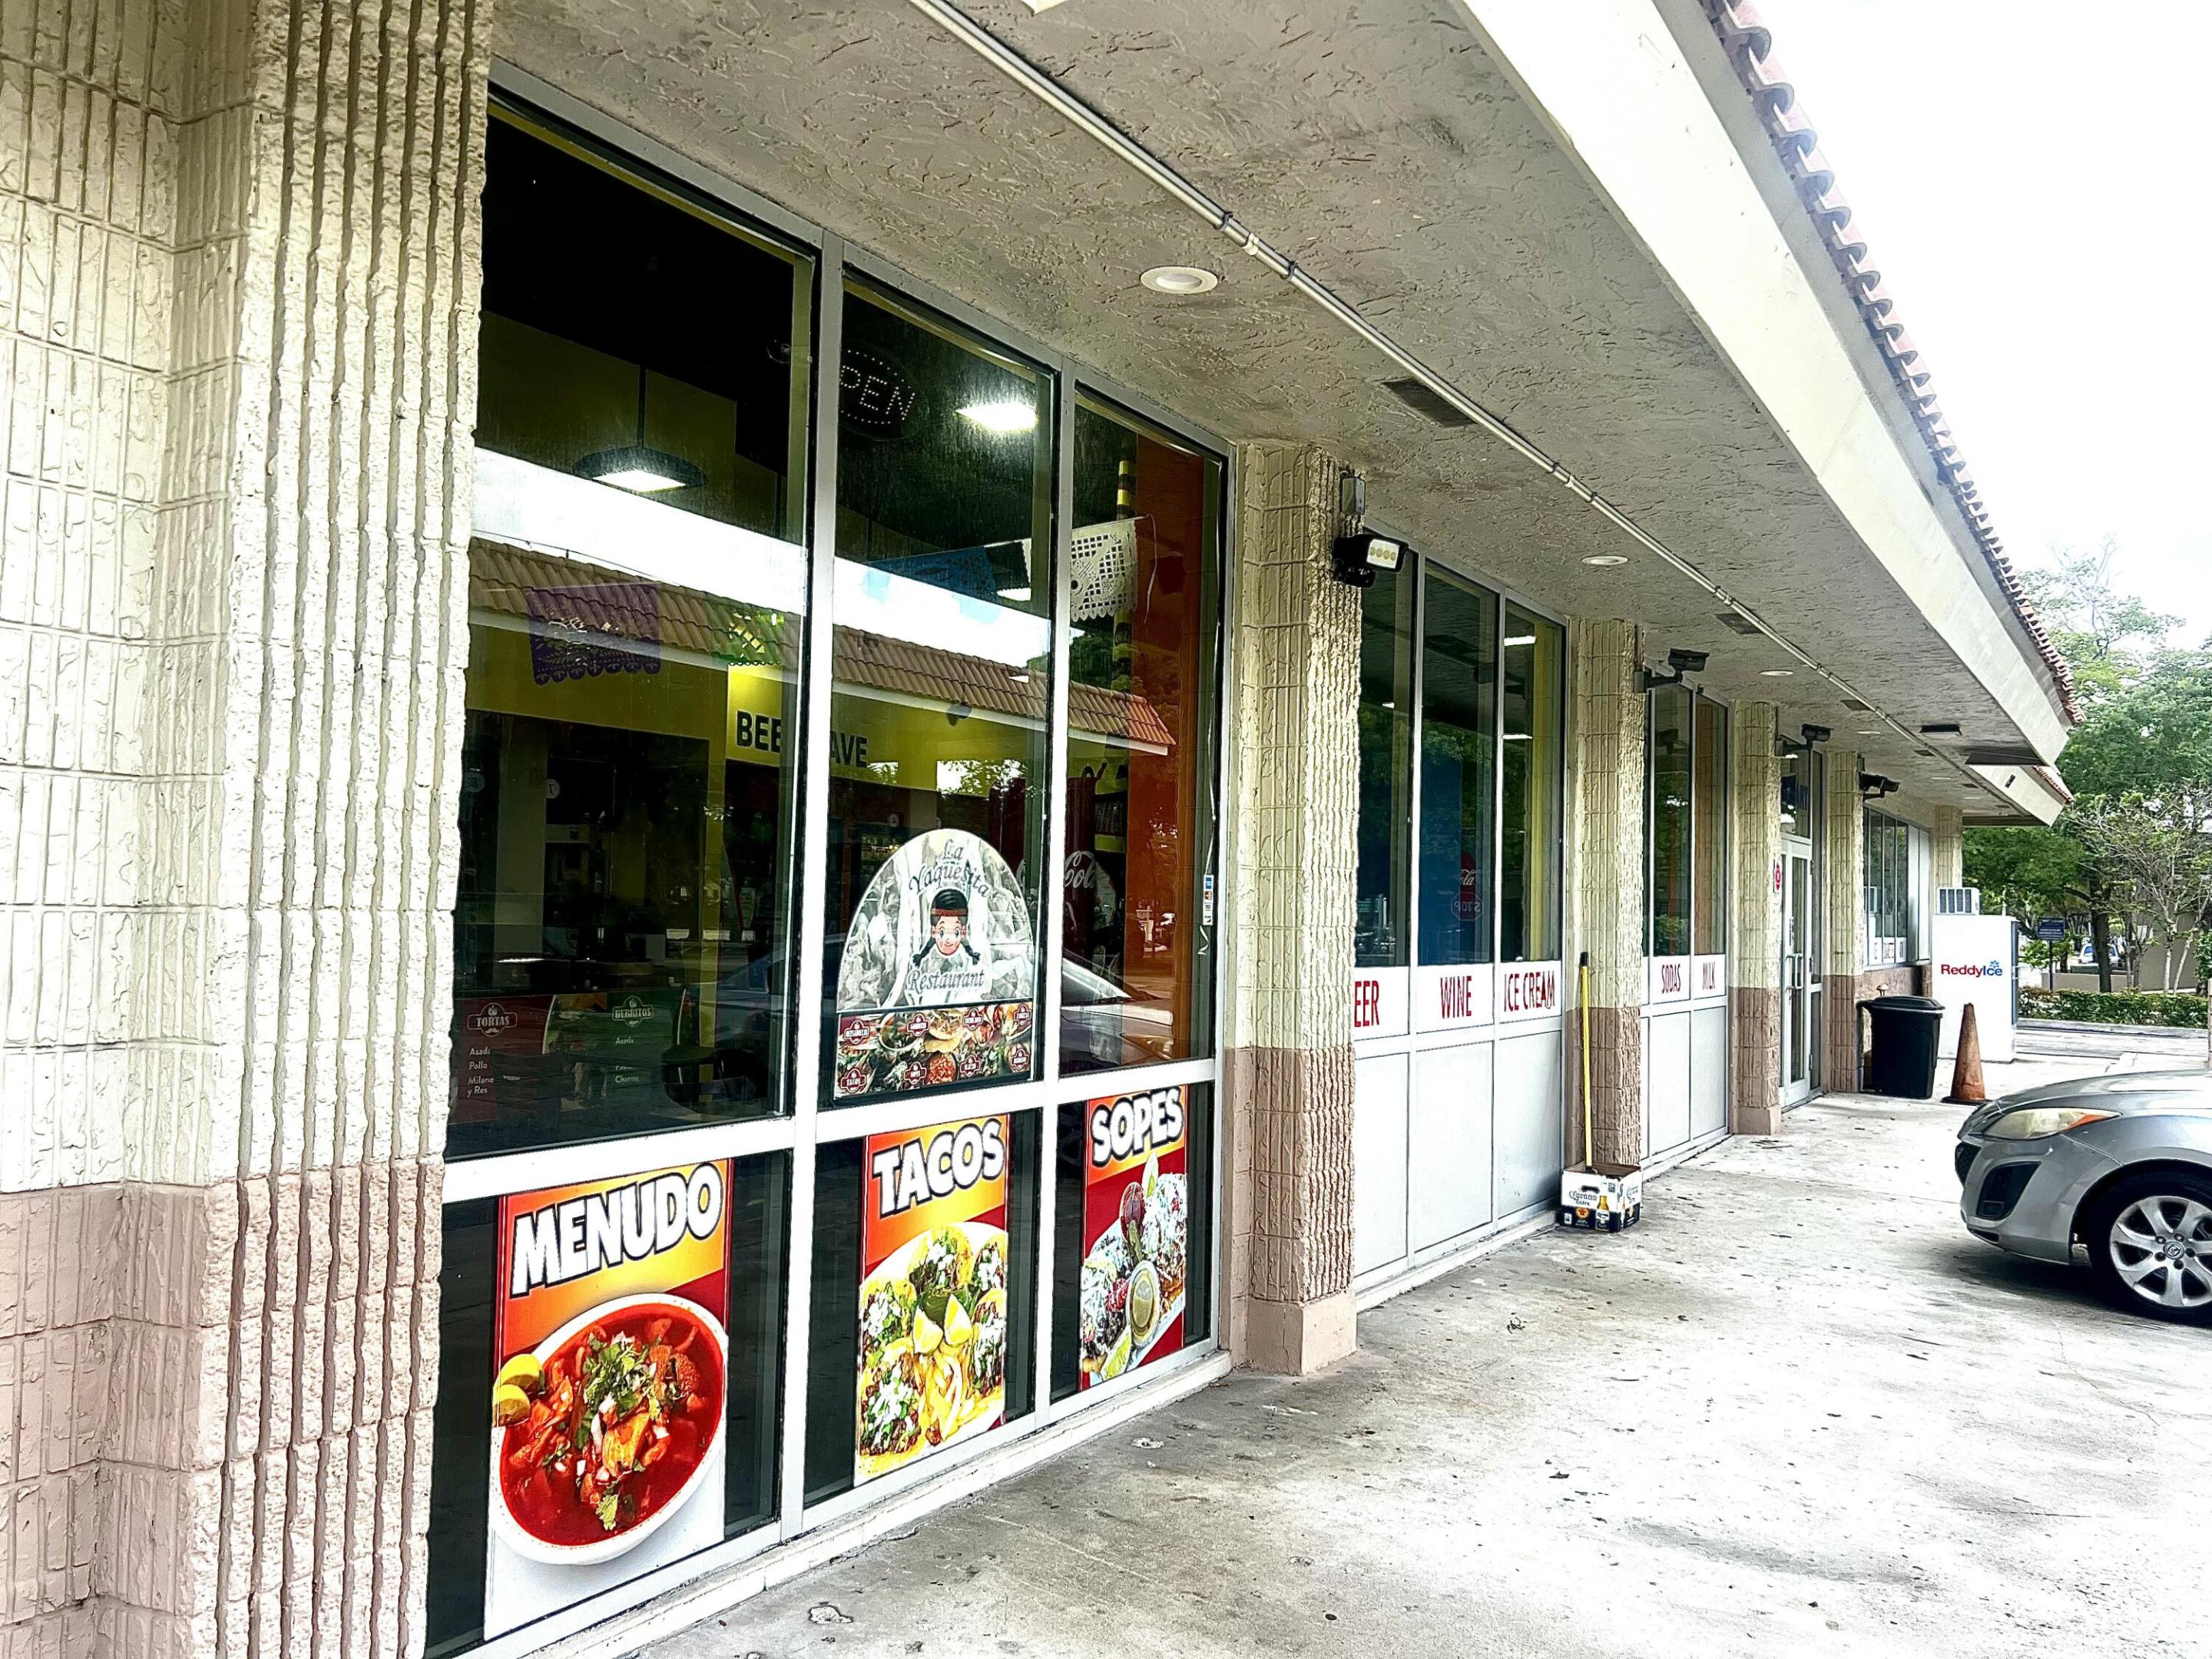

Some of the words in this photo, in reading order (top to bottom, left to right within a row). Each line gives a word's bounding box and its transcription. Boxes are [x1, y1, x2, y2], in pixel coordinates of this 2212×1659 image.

[839, 365, 915, 421] PEN
[737, 710, 781, 753] BEE
[830, 730, 868, 769] AVE
[942, 839, 965, 860] La
[907, 969, 985, 994] Restaurant
[1504, 973, 1520, 1012] ICE
[1523, 970, 1556, 1009] CREAM
[1661, 963, 1681, 994] SODAS
[1702, 961, 1716, 990] MILK
[1354, 980, 1379, 1028] EER
[1440, 975, 1472, 1019] WINE
[476, 1015, 510, 1027] TORTAS
[469, 1061, 488, 1070] Pollo
[474, 1085, 488, 1094] Res
[1091, 1085, 1184, 1167] SOPES
[873, 1118, 1005, 1219] TACOS
[509, 1162, 724, 1298] MENUDO
